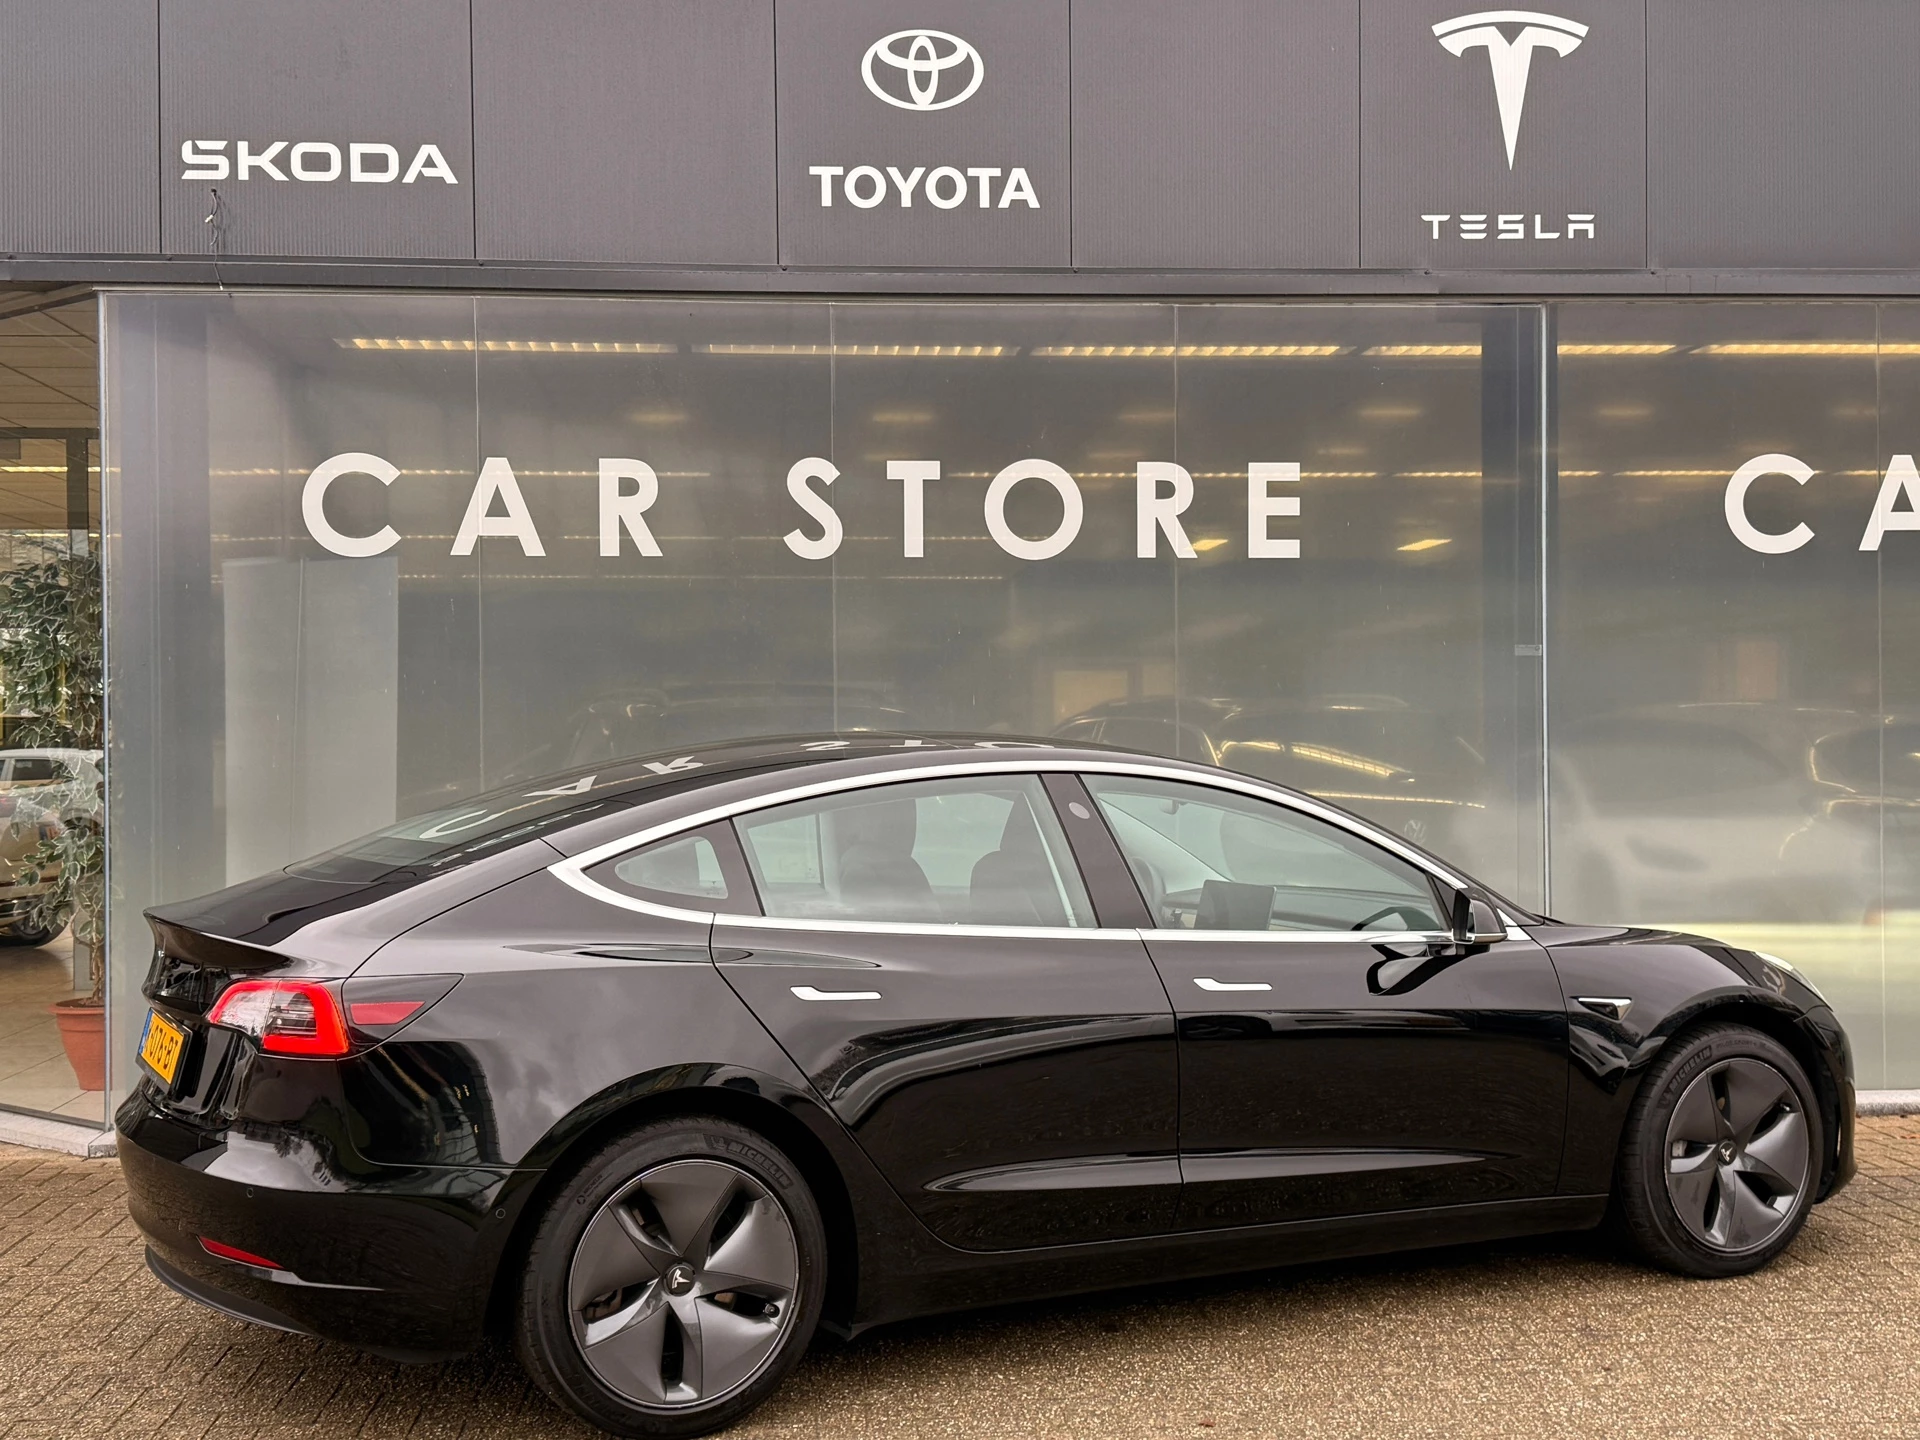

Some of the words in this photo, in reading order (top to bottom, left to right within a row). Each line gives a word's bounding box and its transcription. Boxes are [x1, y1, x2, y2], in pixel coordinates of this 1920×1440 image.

[808, 165, 1041, 210] TOYOTA
[1420, 213, 1596, 241] TESLA
[301, 452, 664, 559] CAR
[783, 457, 1302, 562] STORE
[1668, 1045, 1712, 1092] MICHELIN
[726, 1140, 794, 1189] MICHELIN
